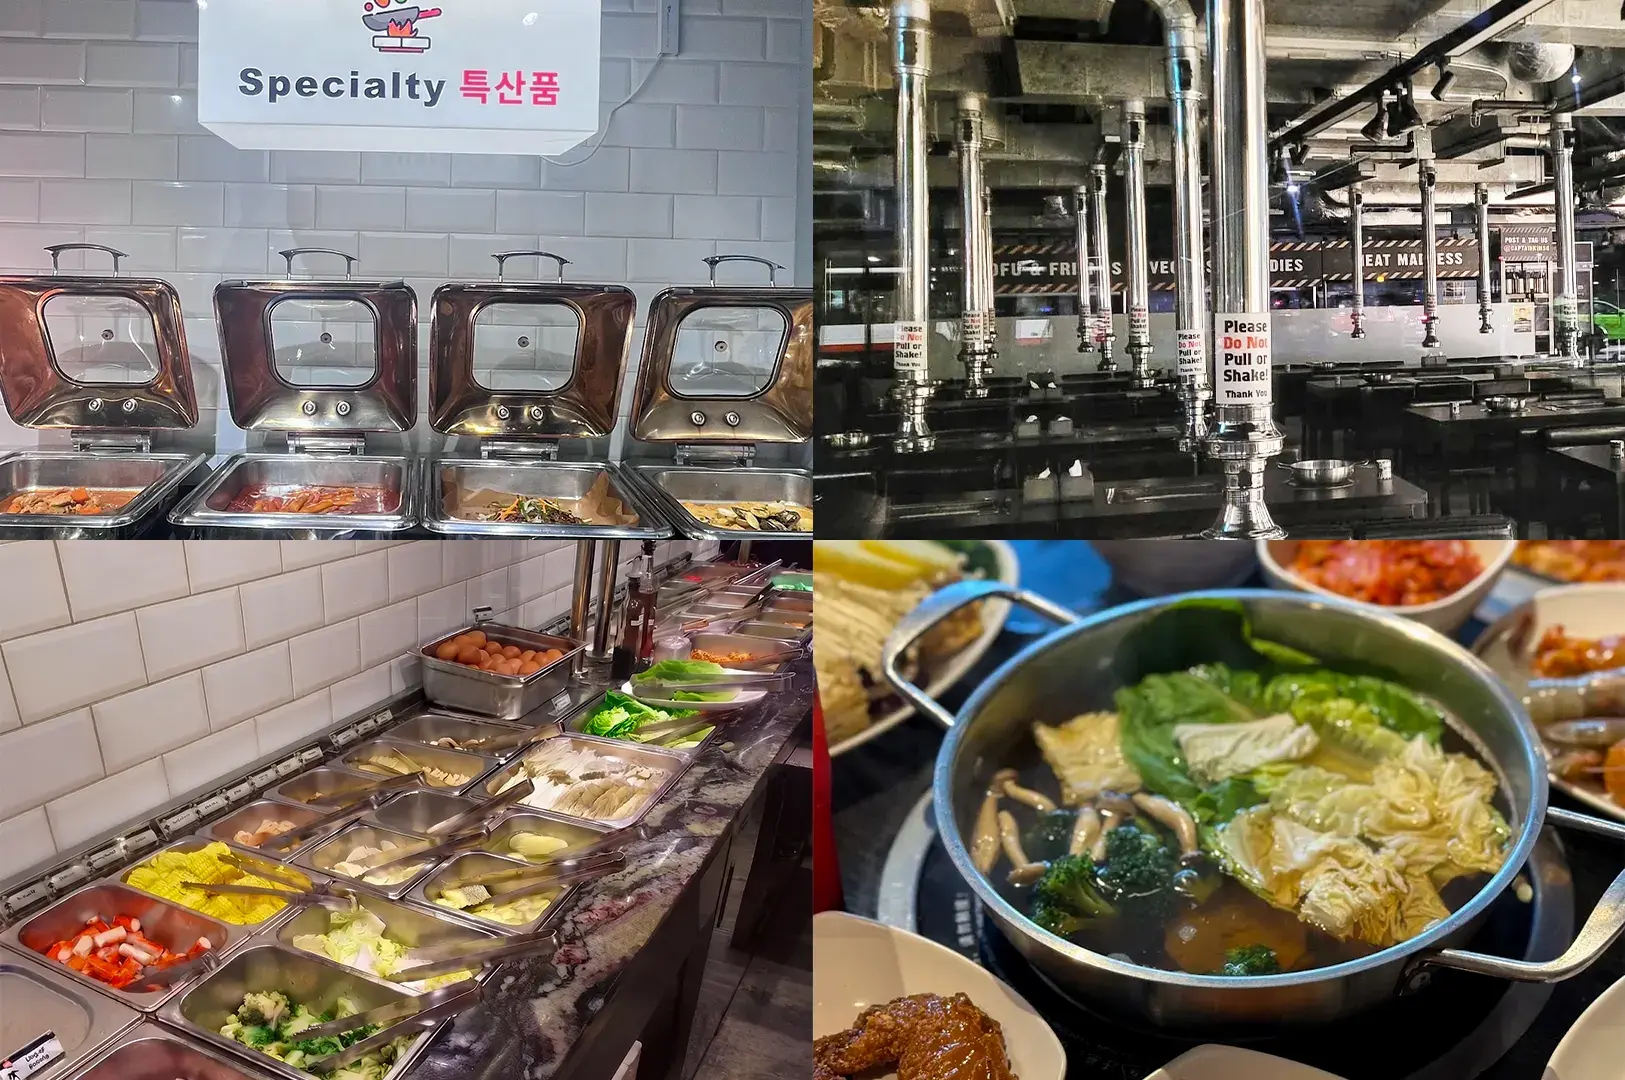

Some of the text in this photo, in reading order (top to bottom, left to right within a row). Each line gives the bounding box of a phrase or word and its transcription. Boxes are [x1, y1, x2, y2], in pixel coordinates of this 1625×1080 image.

[238, 66, 561, 108] Specialty 특산품
[1397, 252, 1463, 266] MAESS
[993, 262, 1021, 276] OFU
[1049, 262, 1122, 276] FRIS
[1224, 320, 1267, 333] Please
[896, 342, 910, 350] Pull
[1223, 336, 1242, 349] Do
[1178, 357, 1203, 365] Shake!
[1224, 353, 1268, 366] Pull or
[1223, 368, 1268, 382] Shake!
[1225, 390, 1253, 398] Thank
